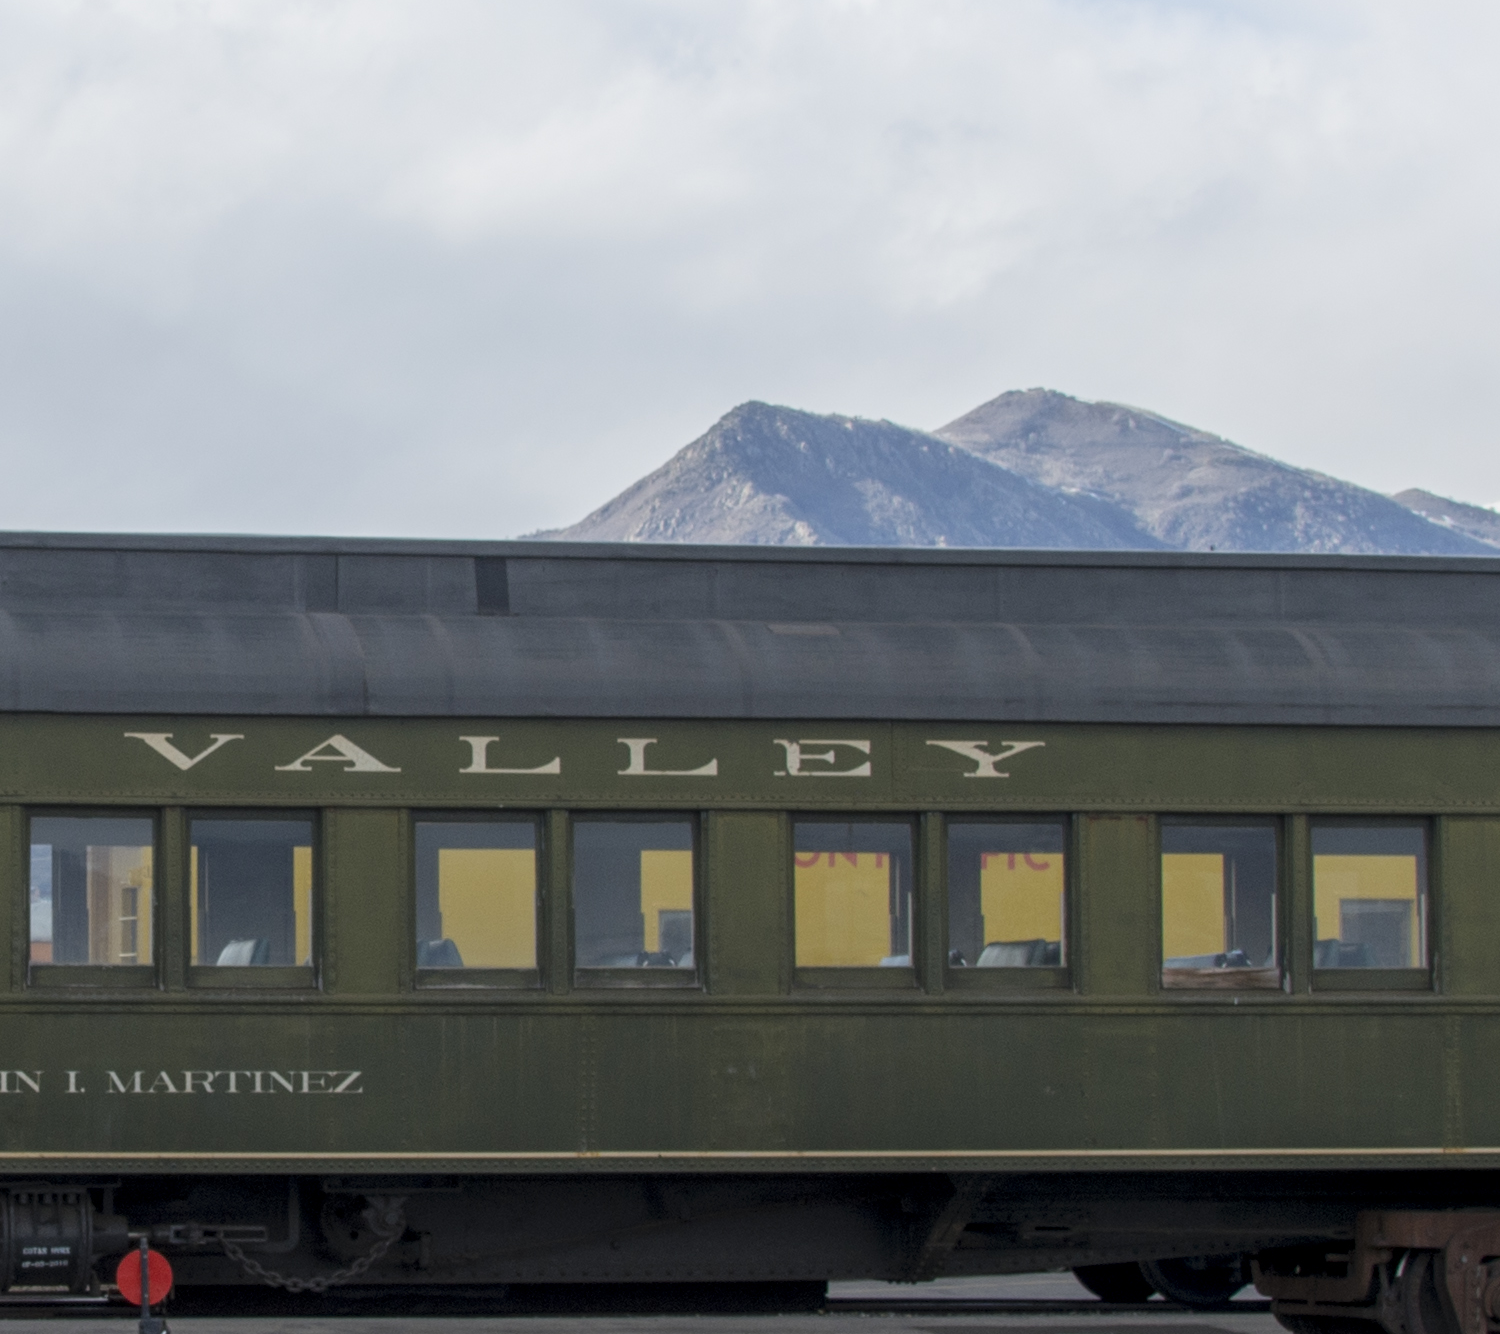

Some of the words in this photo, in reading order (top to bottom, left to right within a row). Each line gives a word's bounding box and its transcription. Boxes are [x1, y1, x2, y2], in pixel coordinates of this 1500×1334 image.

[123, 732, 1047, 780] VALLEY
[64, 1070, 86, 1094] I.
[105, 1070, 364, 1094] MARTINEZ
